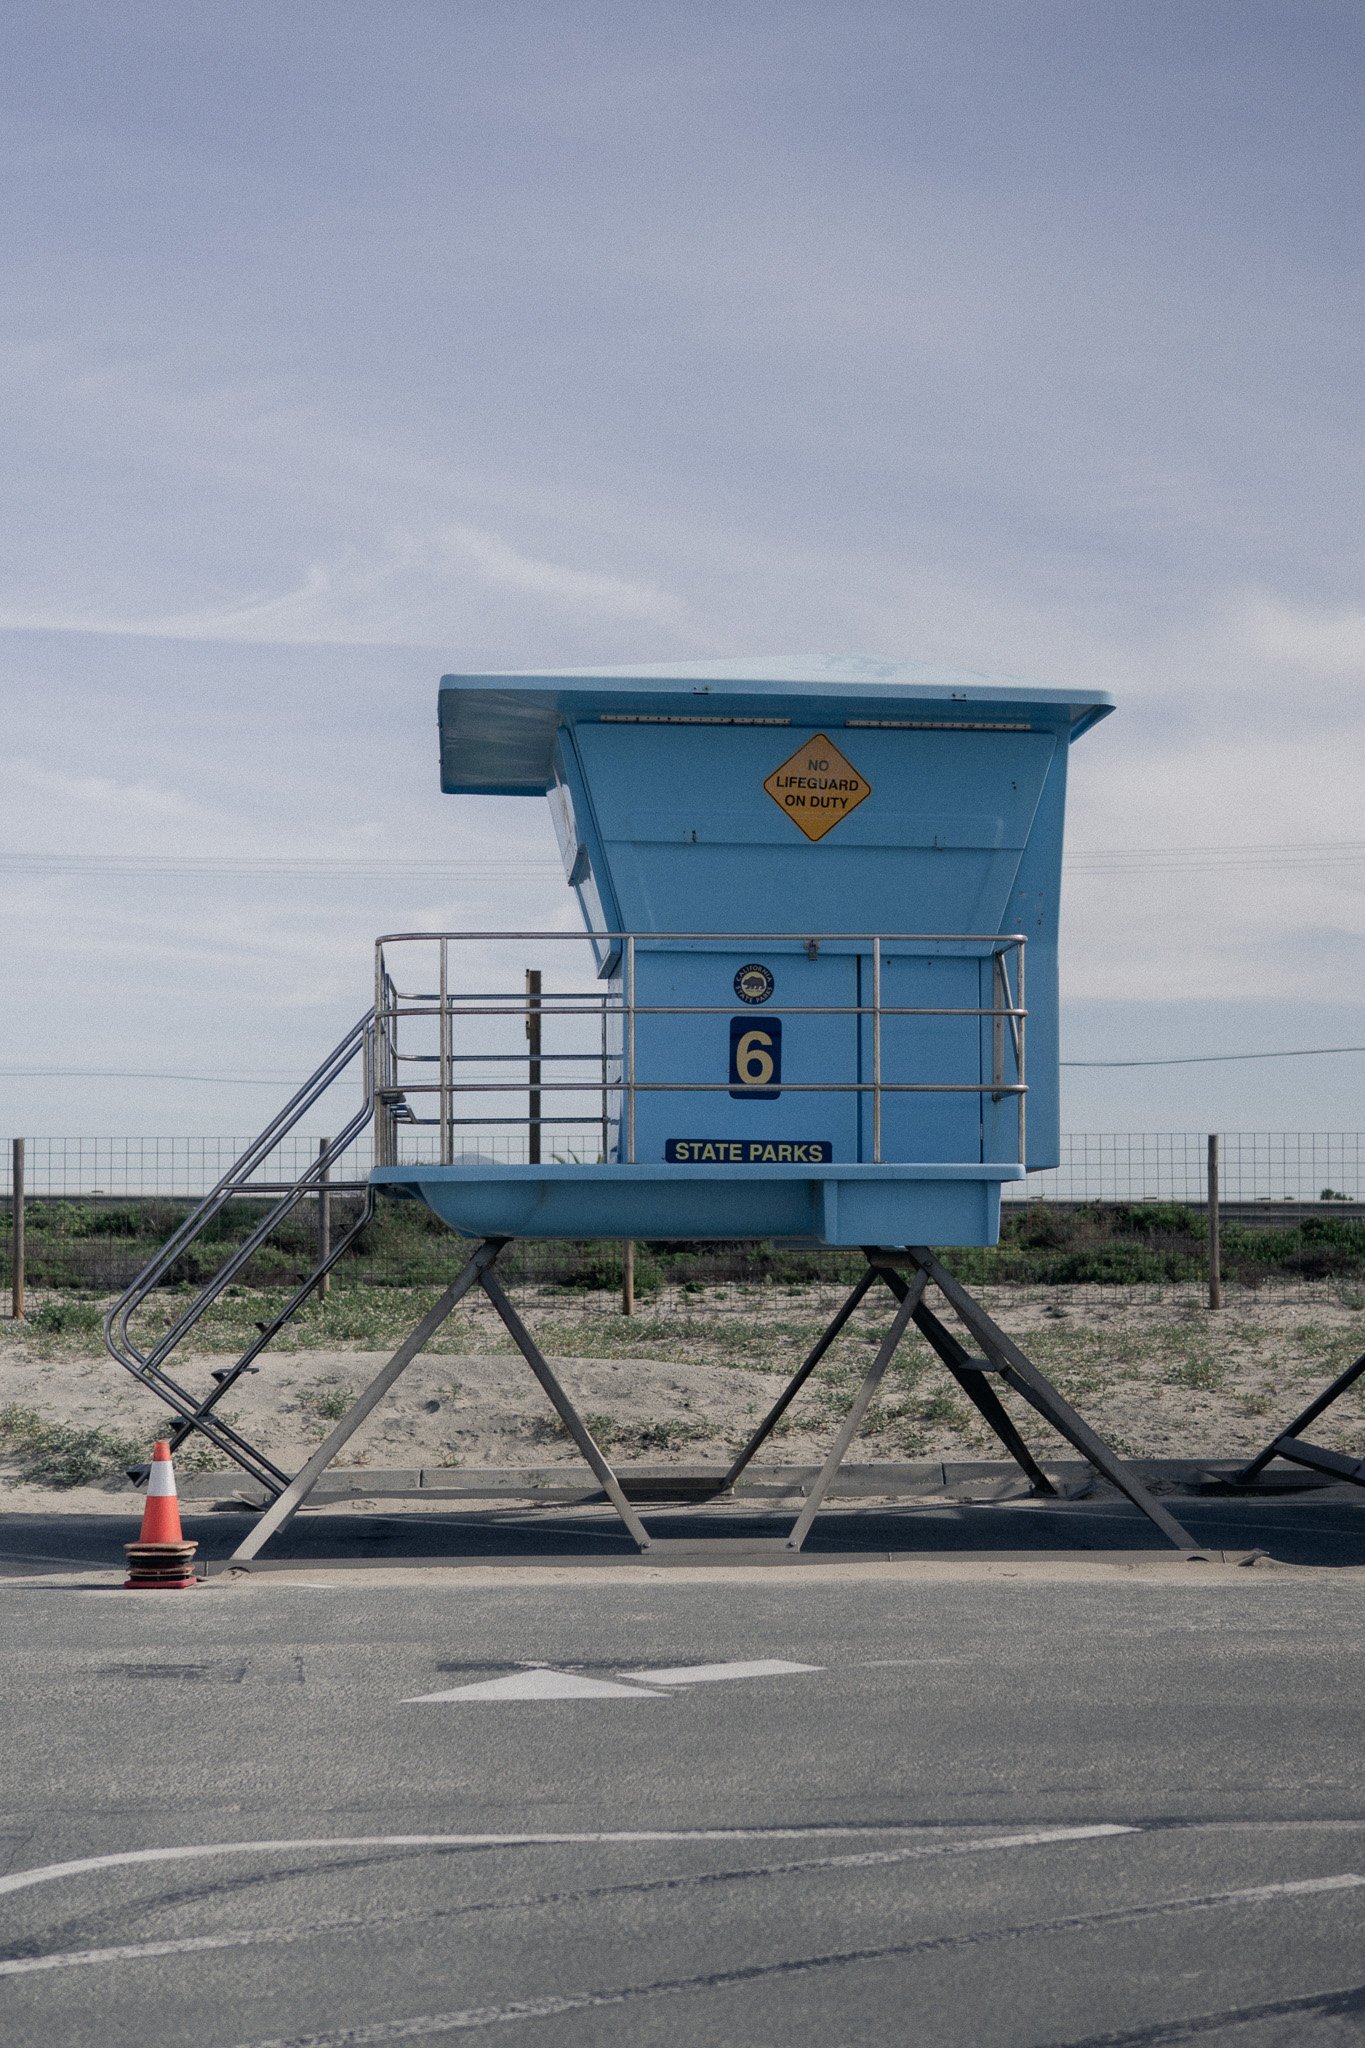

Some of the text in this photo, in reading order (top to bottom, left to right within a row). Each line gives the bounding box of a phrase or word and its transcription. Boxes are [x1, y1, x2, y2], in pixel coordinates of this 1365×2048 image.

[808, 759, 830, 771] NO
[776, 776, 859, 791] LIFEGUARD
[784, 794, 848, 809] ON DUTY
[736, 965, 773, 982] CALIFORNIA
[735, 985, 773, 1004] STATE PARKS
[736, 1030, 774, 1085] 6
[675, 1142, 823, 1163] STATE PARKS
